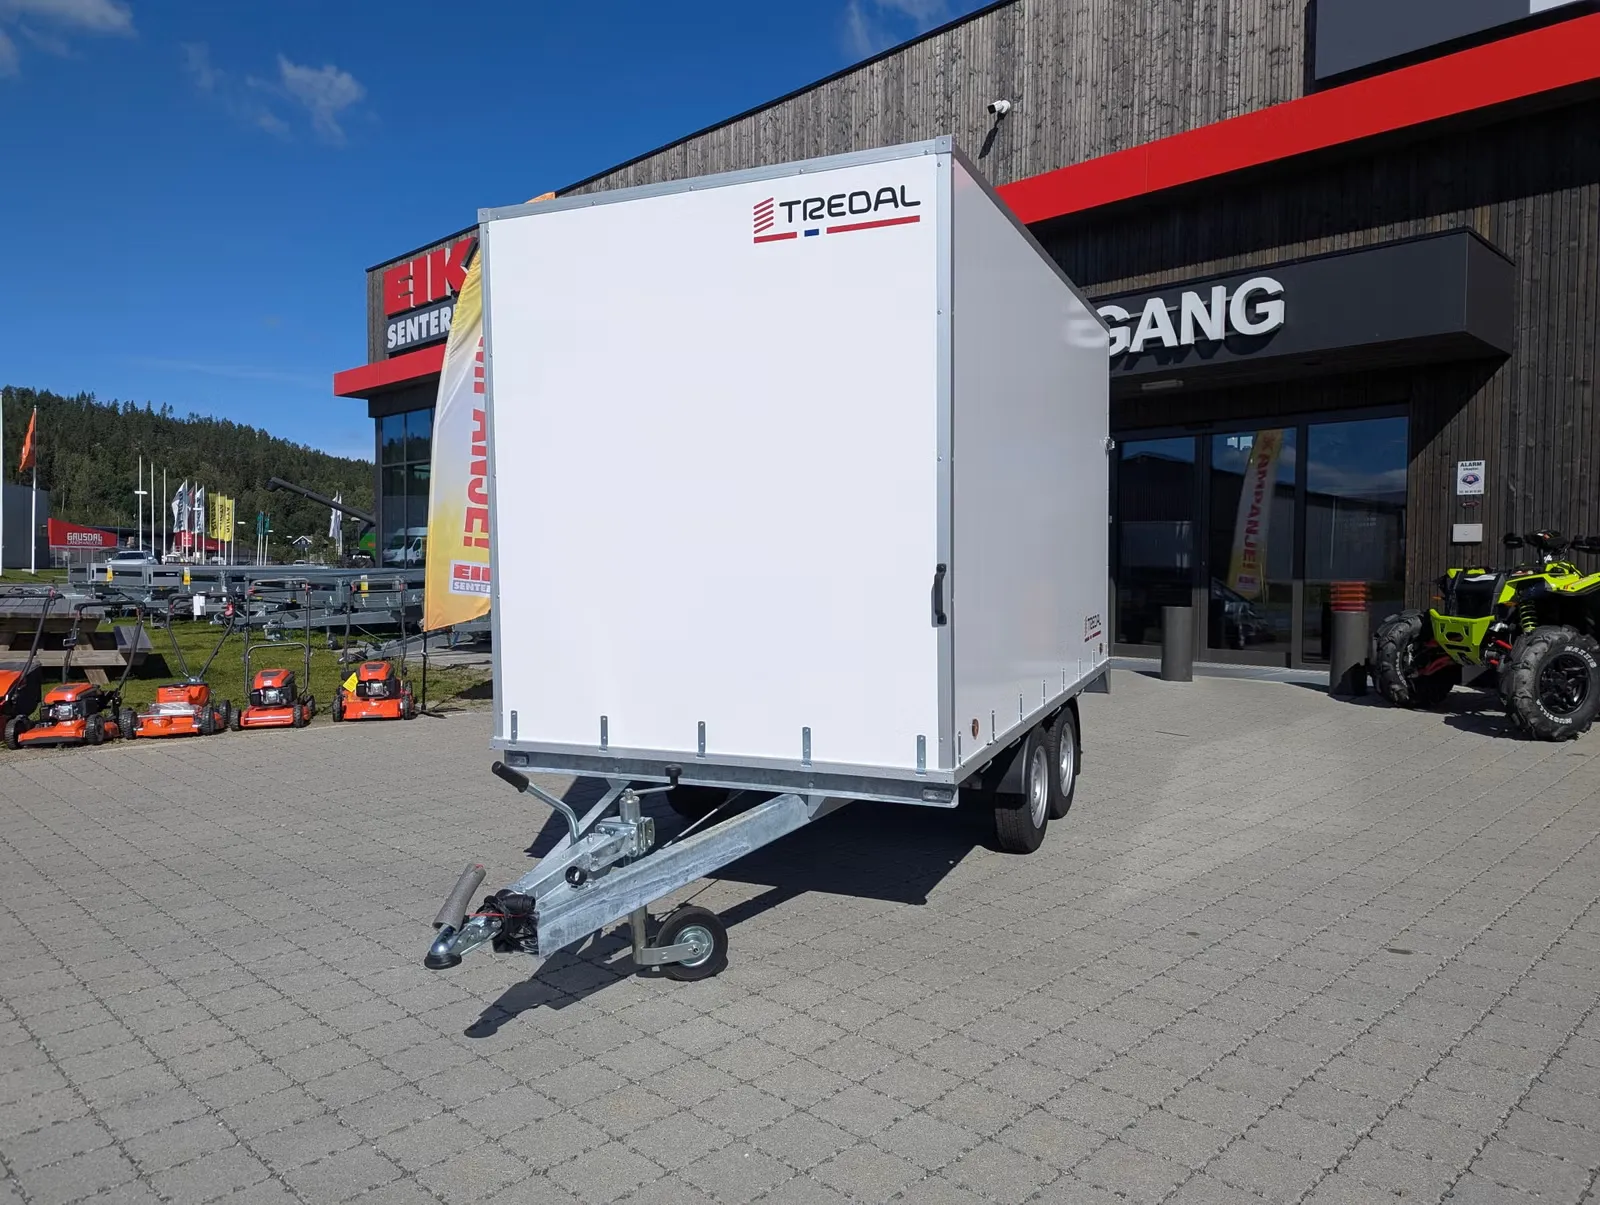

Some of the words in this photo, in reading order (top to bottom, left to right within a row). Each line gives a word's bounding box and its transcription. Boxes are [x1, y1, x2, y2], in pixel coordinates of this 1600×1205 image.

[779, 184, 921, 223] TREDAL
[383, 236, 477, 316] EIK
[1564, 645, 1598, 669] MAXXIS
